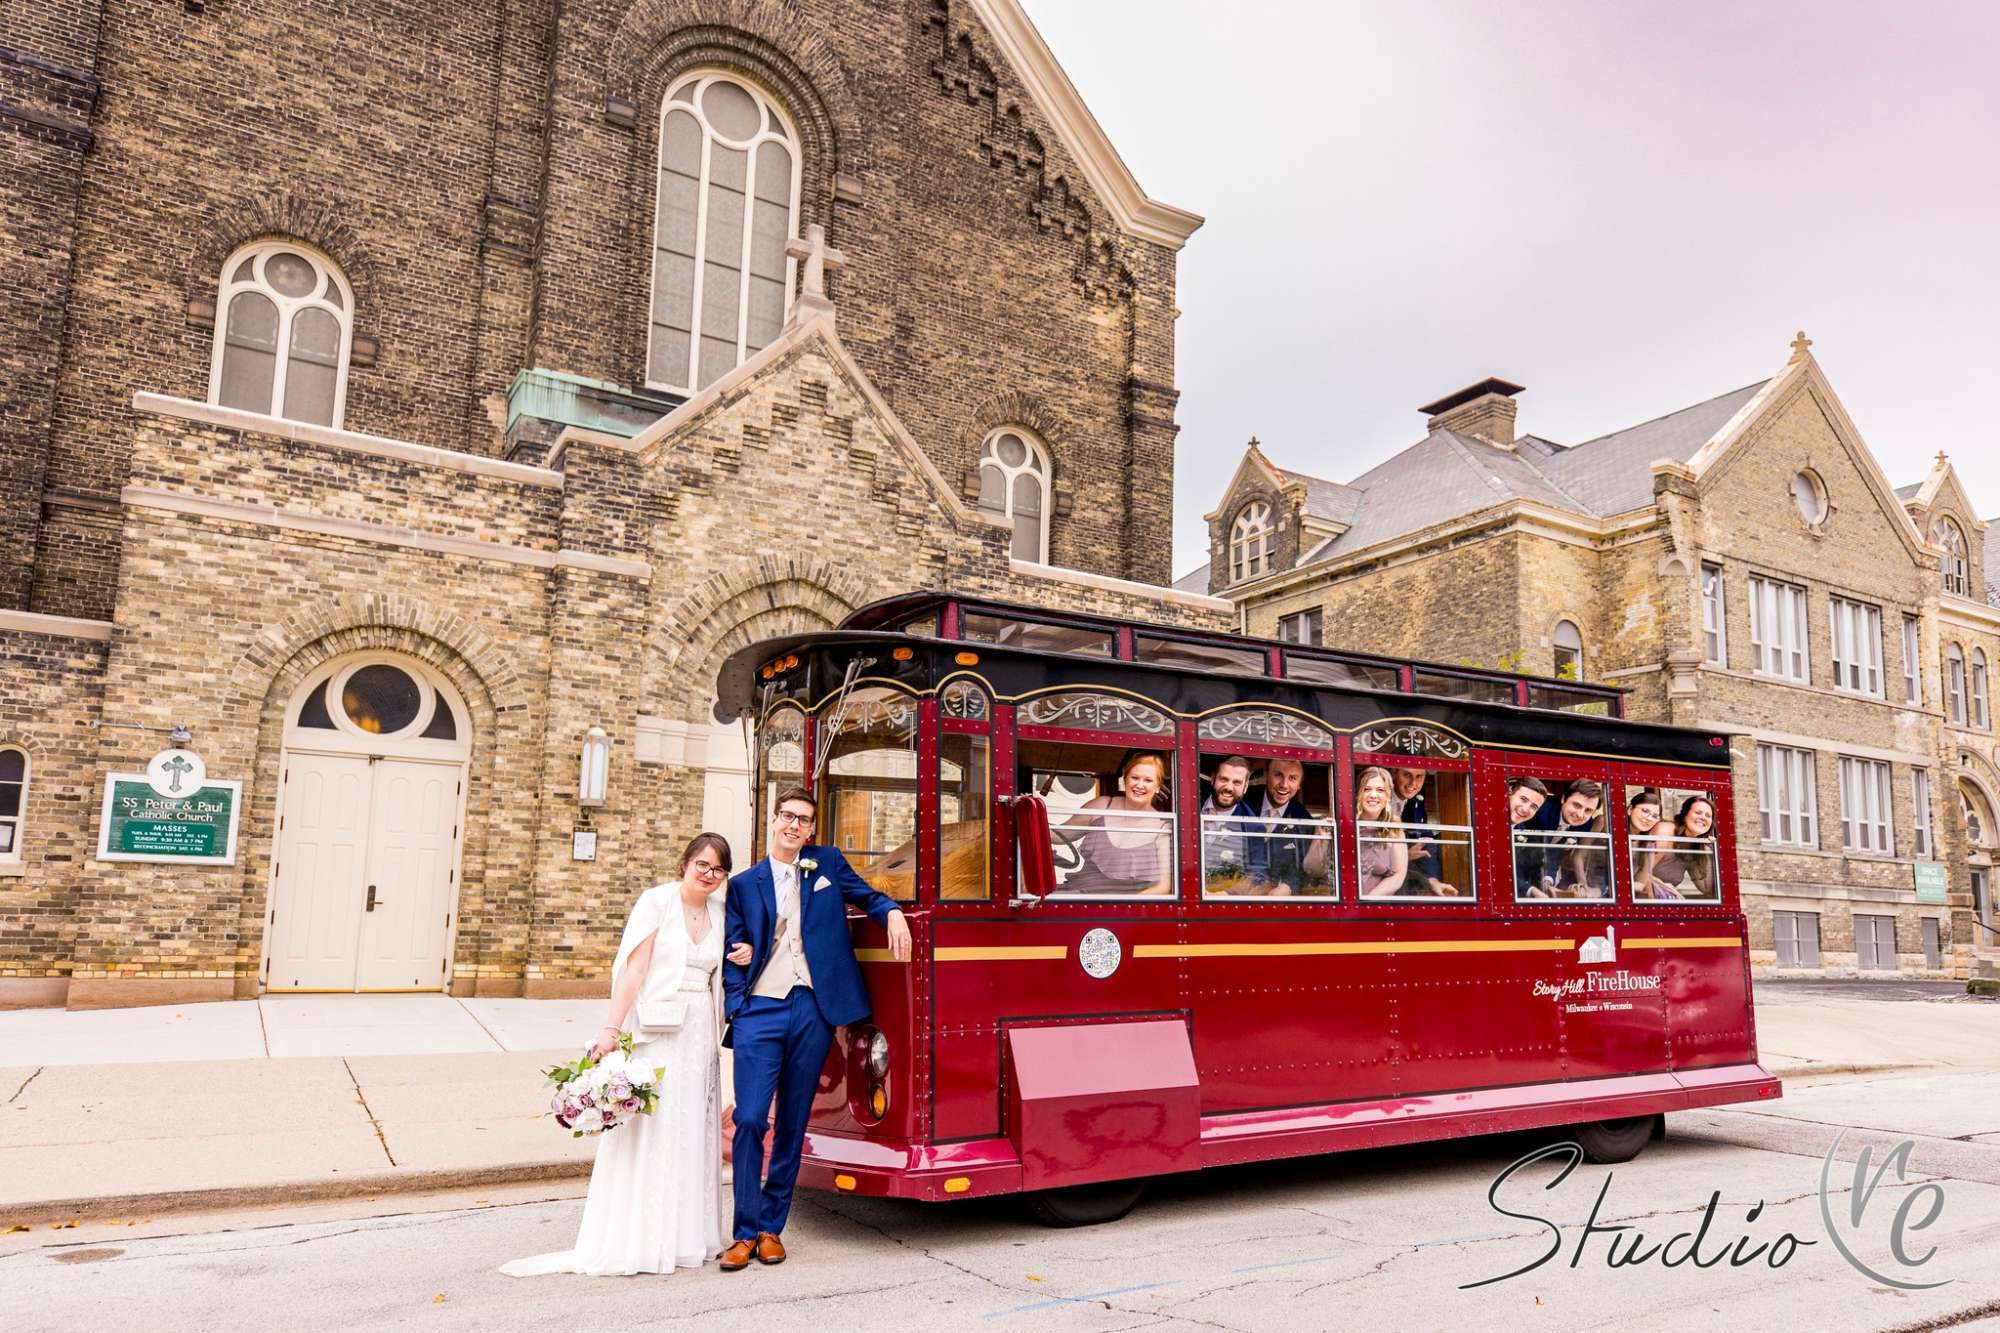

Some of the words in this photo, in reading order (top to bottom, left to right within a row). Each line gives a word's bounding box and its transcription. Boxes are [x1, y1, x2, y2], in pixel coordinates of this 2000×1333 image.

[122, 797, 138, 808] SS
[145, 798, 176, 810] Peter
[182, 801, 192, 811] &
[197, 801, 223, 813] Paul
[130, 809, 173, 820] Catholic
[176, 811, 213, 822] Church
[153, 825, 188, 833] MASSES
[1533, 980, 1561, 1002] Story
[1586, 969, 1661, 992] FireHouse
[1565, 1003, 1598, 1013] Milwaukee
[1603, 1001, 1633, 1011] Wisconsin
